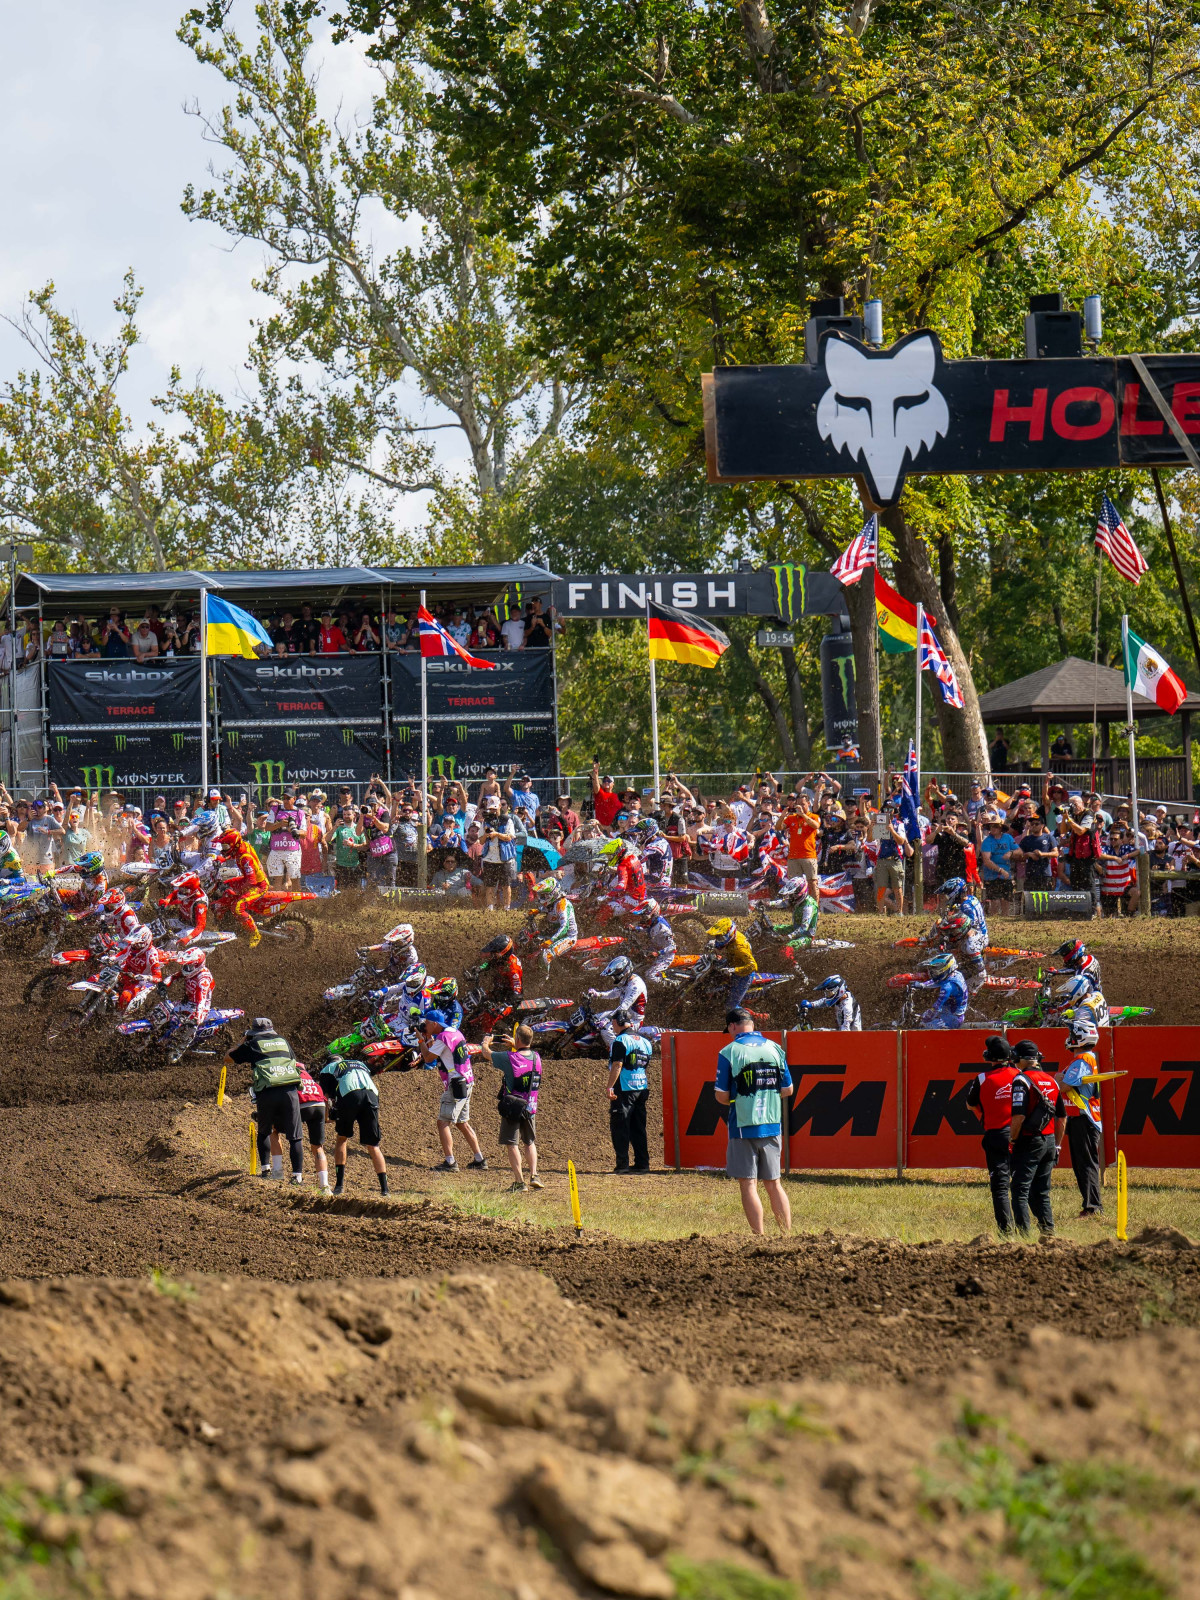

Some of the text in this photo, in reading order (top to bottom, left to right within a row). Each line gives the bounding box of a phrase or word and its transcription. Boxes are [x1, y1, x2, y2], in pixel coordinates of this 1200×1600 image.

[568, 581, 736, 609] FINISH
[765, 632, 795, 644] 19:54
[85, 670, 175, 683] Skybox
[255, 665, 344, 679] Skybox
[277, 702, 325, 711] TERRACE
[448, 697, 495, 706] TERRACE
[106, 706, 156, 716] TERRACE
[116, 773, 186, 785] MONSTER
[287, 768, 356, 780] MONSTER
